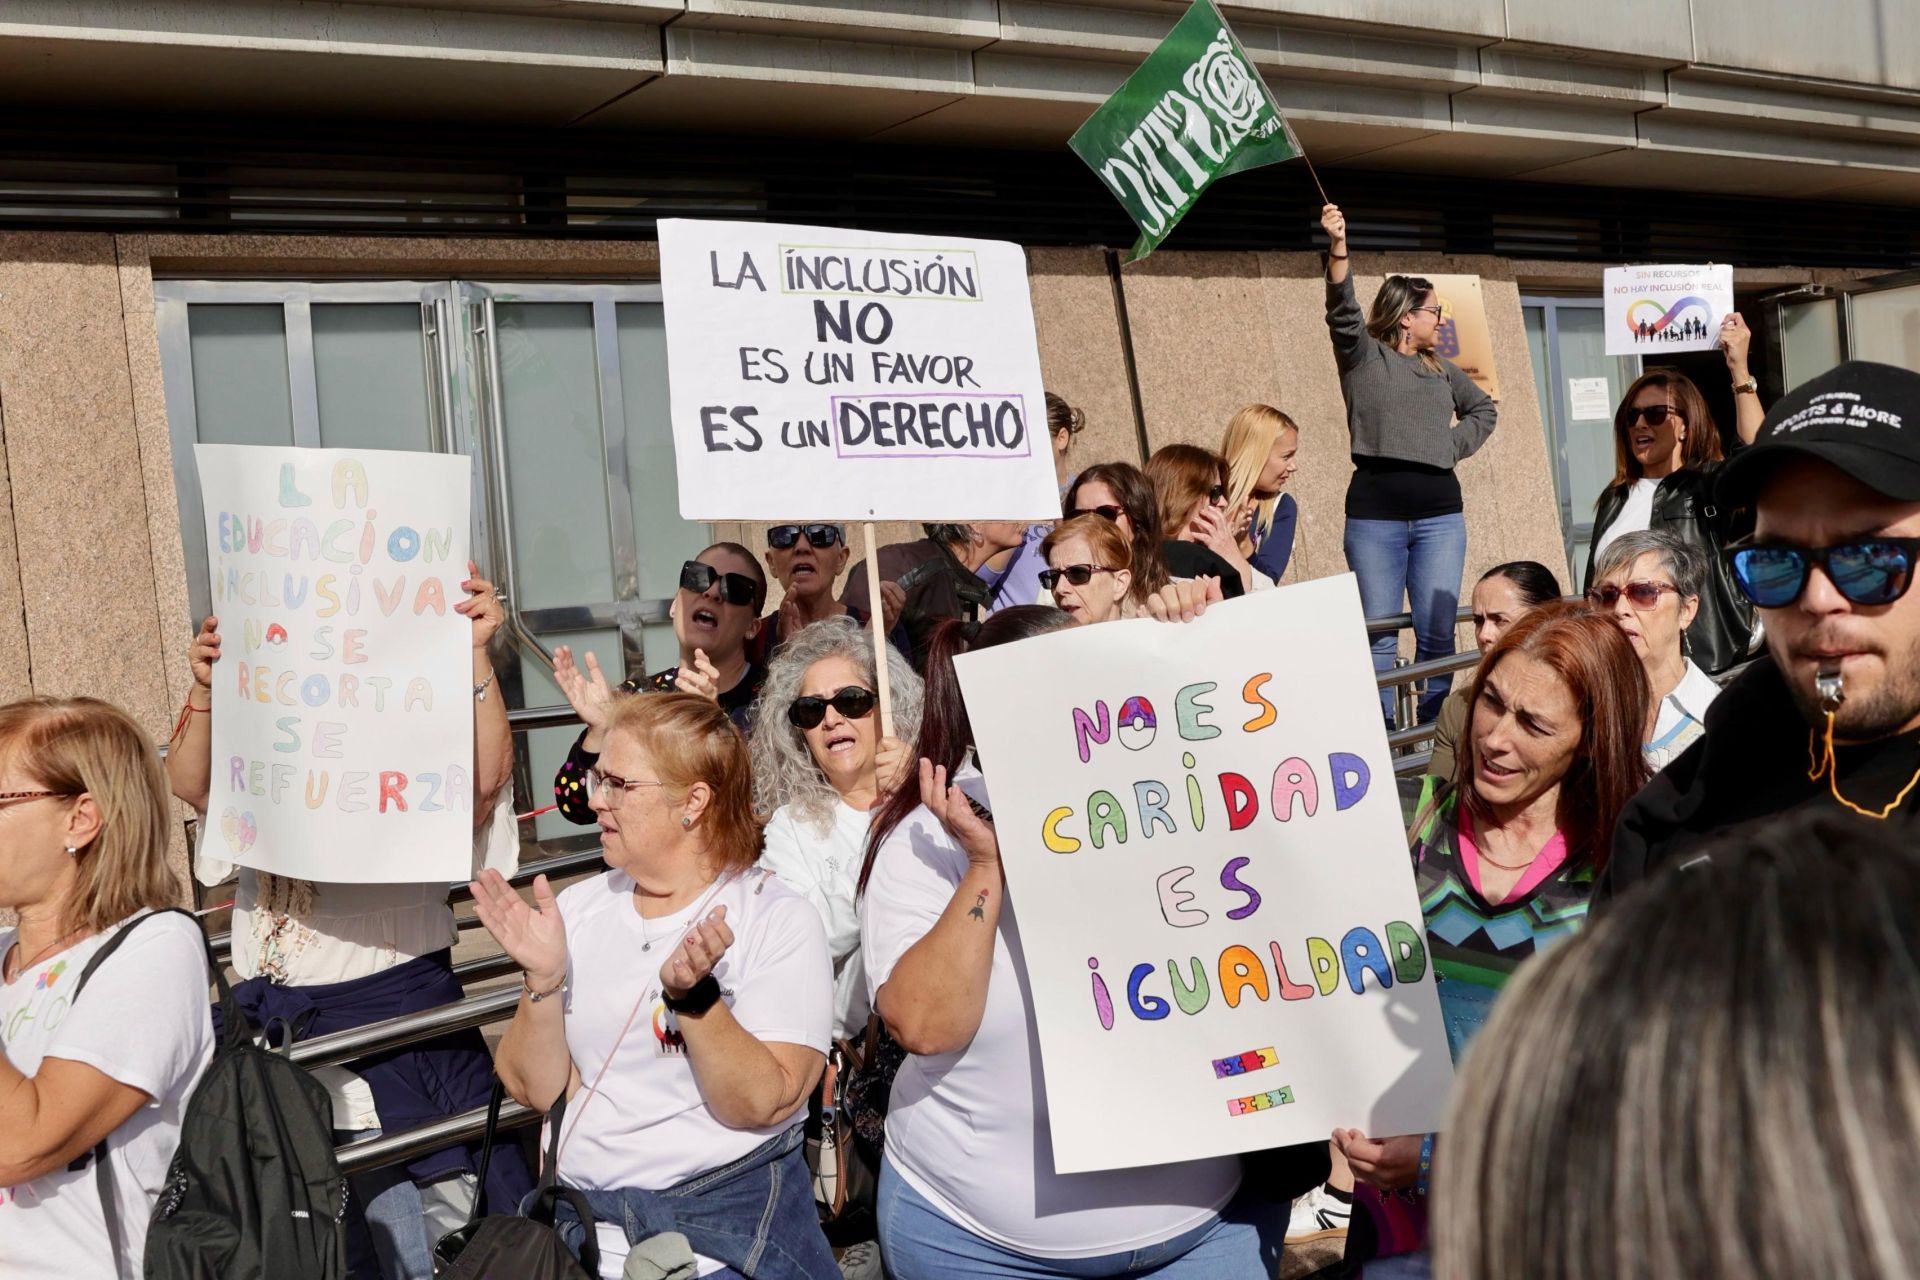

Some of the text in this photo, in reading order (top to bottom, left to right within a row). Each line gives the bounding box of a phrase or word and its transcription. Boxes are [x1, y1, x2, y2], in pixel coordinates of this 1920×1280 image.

[710, 250, 767, 292] LA
[1613, 286, 1628, 294] NO
[1631, 284, 1648, 293] HAY
[1636, 271, 1651, 279] SIN
[814, 299, 893, 345] NO
[739, 346, 981, 388] ES UN FAVOR
[700, 400, 1024, 452] ES UN DERECHO
[1830, 403, 1844, 415] &
[1850, 404, 1902, 429] MORE
[278, 459, 369, 509] LA
[244, 618, 369, 664] NO SE
[238, 661, 434, 713] RECORTA
[273, 716, 348, 760] SE
[1073, 672, 1278, 764] NO ES
[229, 755, 472, 814] REFUERZA
[1156, 856, 1262, 928] ES
